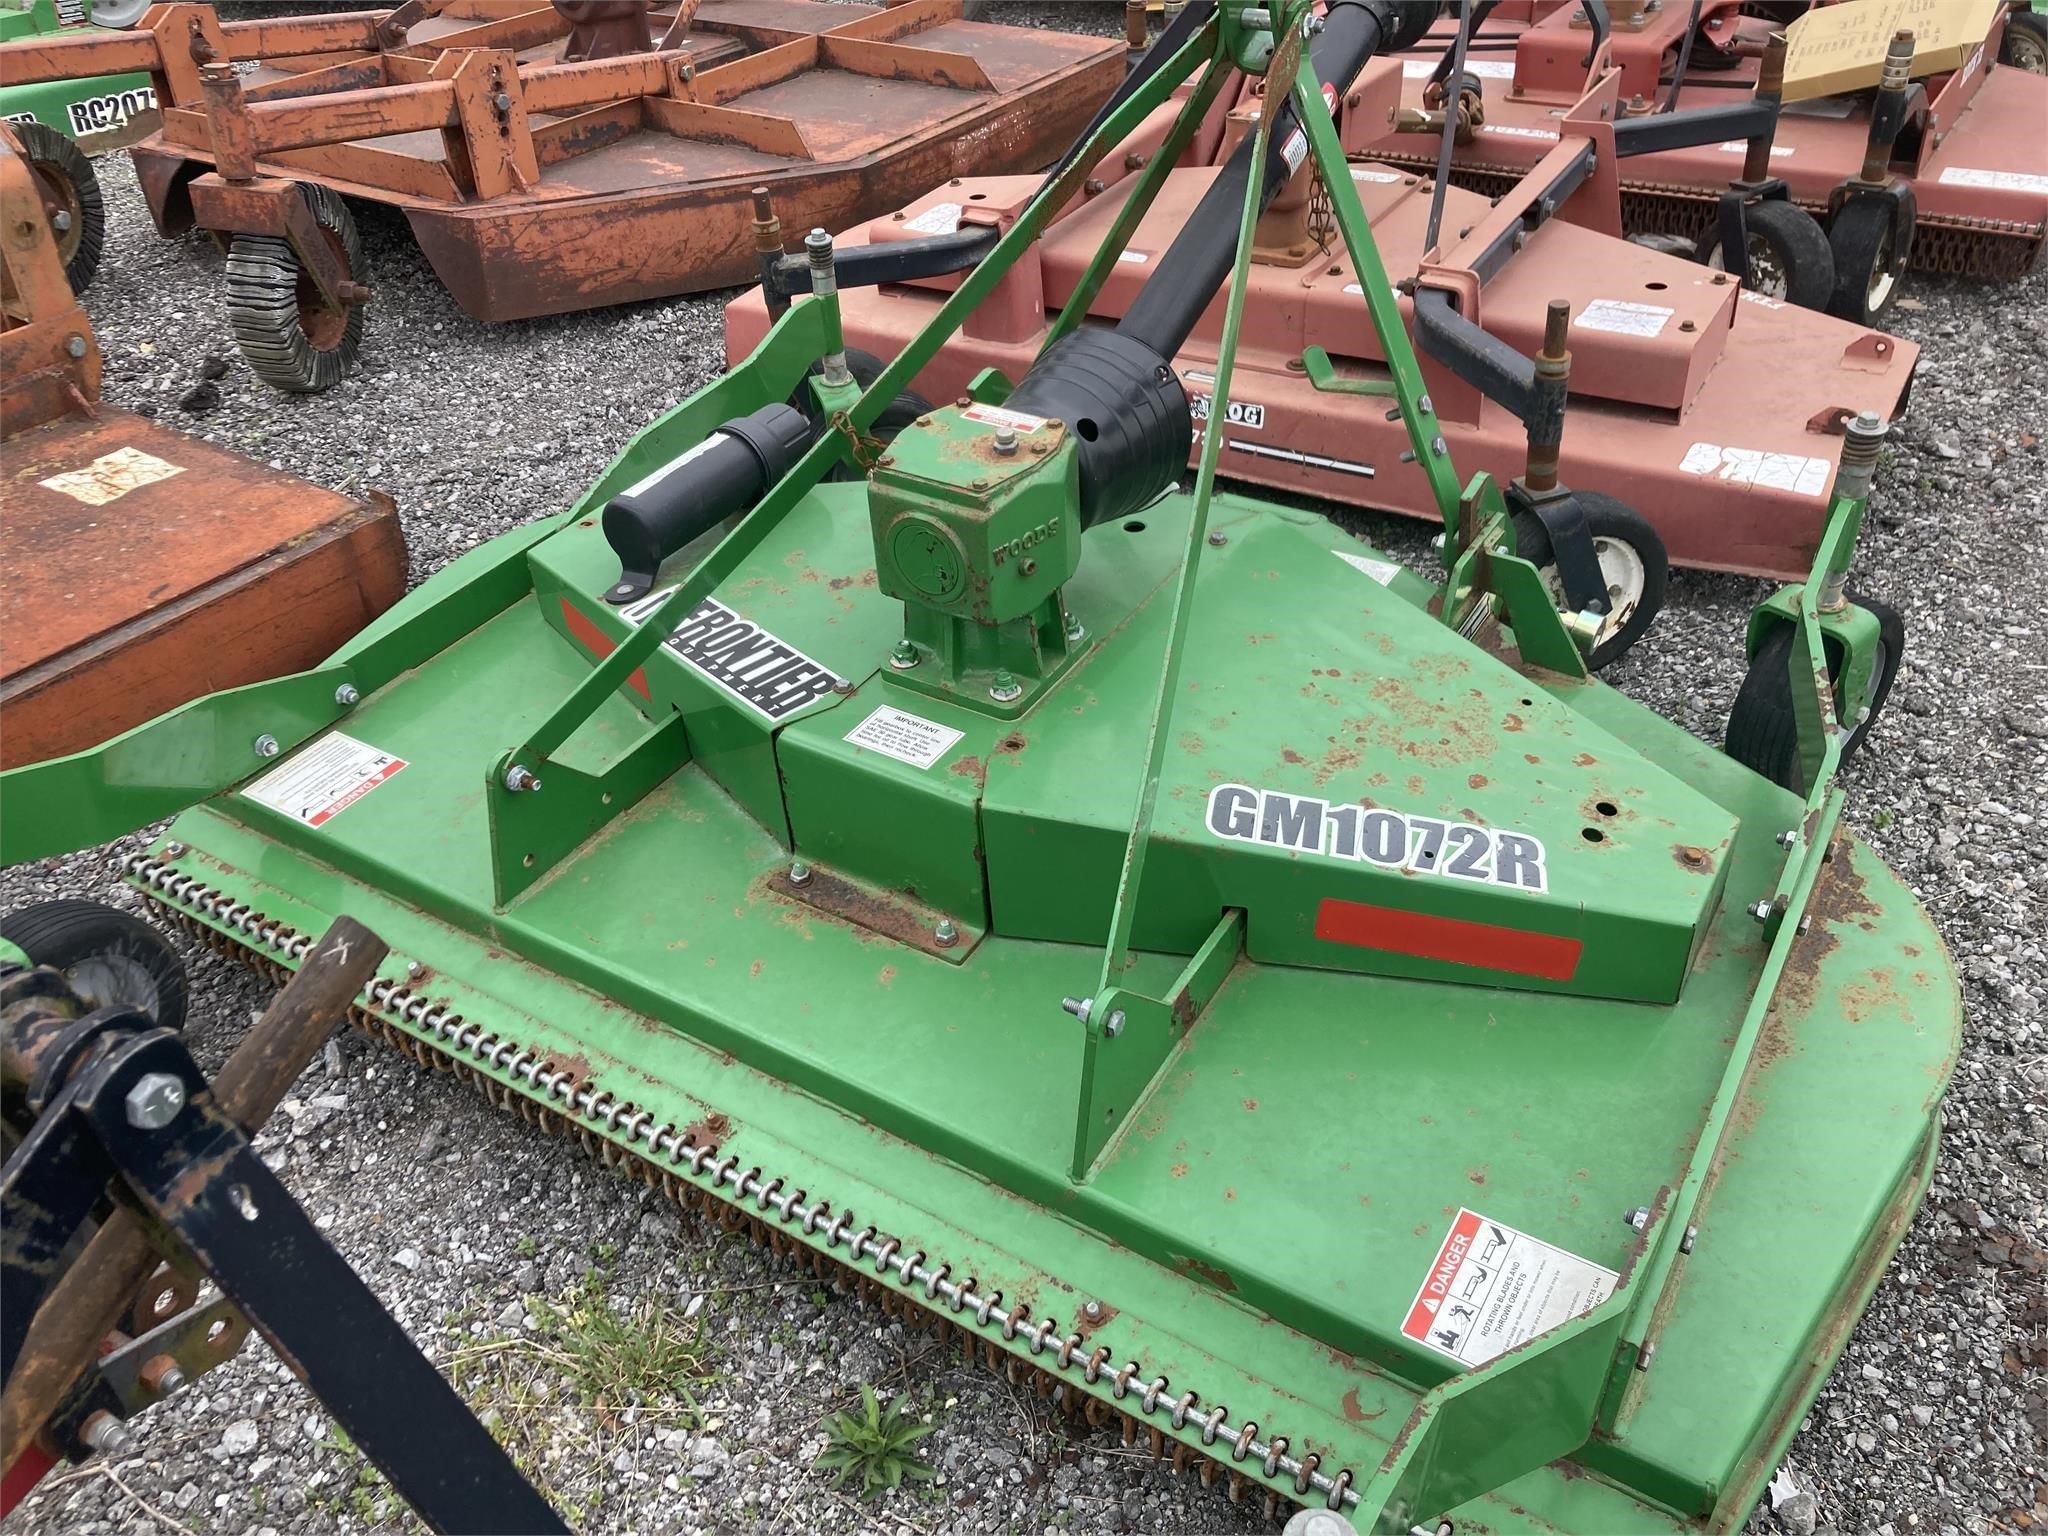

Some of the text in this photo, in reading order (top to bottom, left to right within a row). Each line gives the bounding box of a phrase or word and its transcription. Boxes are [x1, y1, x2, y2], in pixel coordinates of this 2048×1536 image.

[71, 89, 155, 132] RC207
[1225, 401, 1260, 425] OG
[993, 517, 1059, 567] WOODS
[669, 638, 780, 711] QUIPMENT
[894, 715, 939, 734] IMPORTANT
[325, 780, 375, 816] DANGER
[1209, 785, 1544, 890] GM1072R
[1430, 1232, 1471, 1295] DANGER
[1480, 1261, 1520, 1337] ROTATING BLADES AND
[1494, 1273, 1527, 1334] THROWN OBJECTS
[1583, 1278, 1601, 1312] OBJECTS CAN
